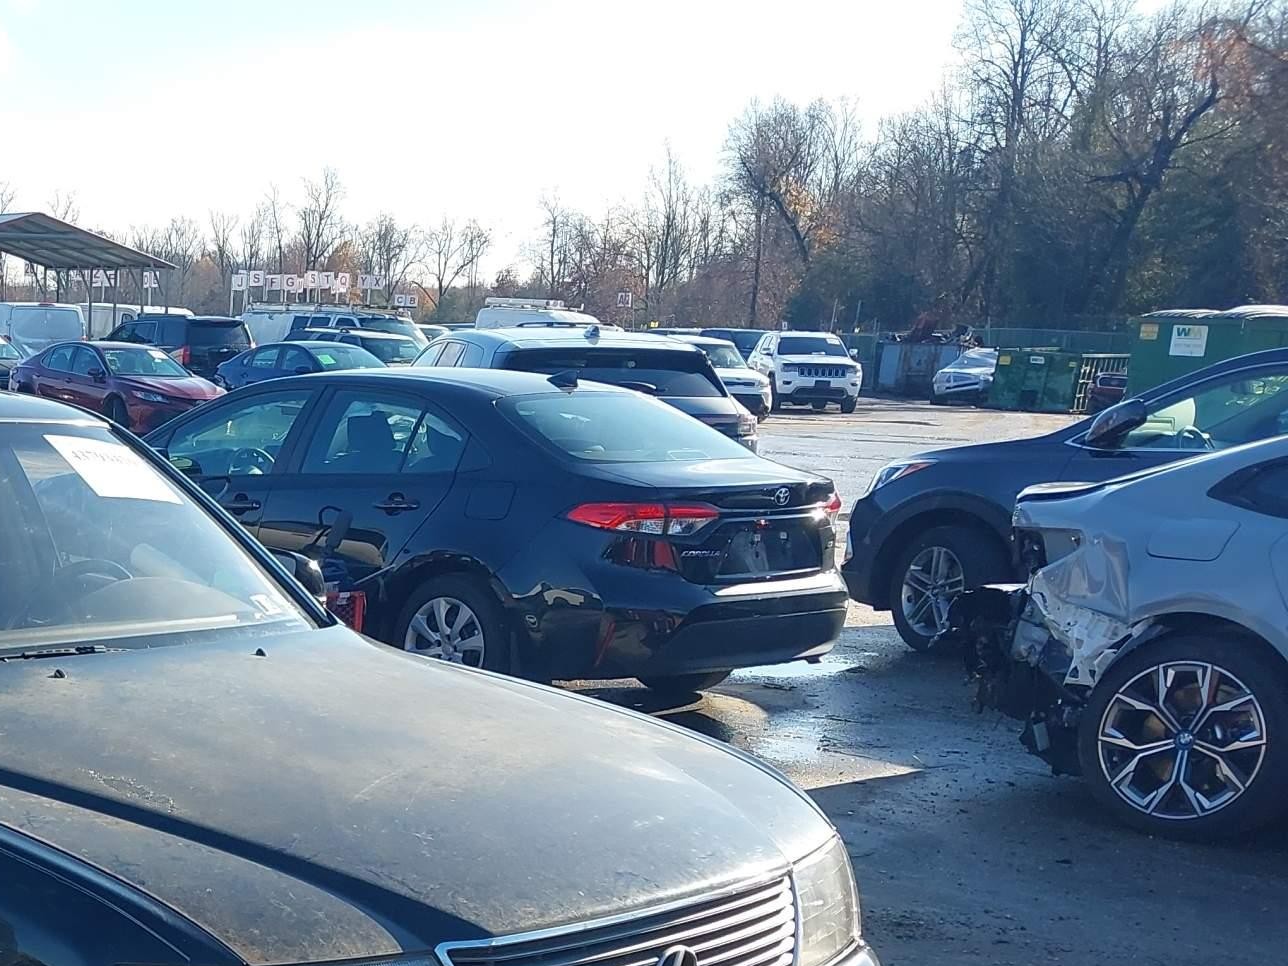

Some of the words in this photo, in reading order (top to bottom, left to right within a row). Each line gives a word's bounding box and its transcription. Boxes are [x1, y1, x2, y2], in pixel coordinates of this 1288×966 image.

[237, 277, 243, 287] J
[253, 273, 260, 283] S
[271, 278, 277, 287] F
[286, 277, 295, 287] G
[324, 274, 330, 284] T
[339, 275, 348, 286] Q
[360, 276, 368, 286] Y
[374, 276, 381, 287] X
[396, 296, 404, 304] C
[409, 296, 416, 304] B
